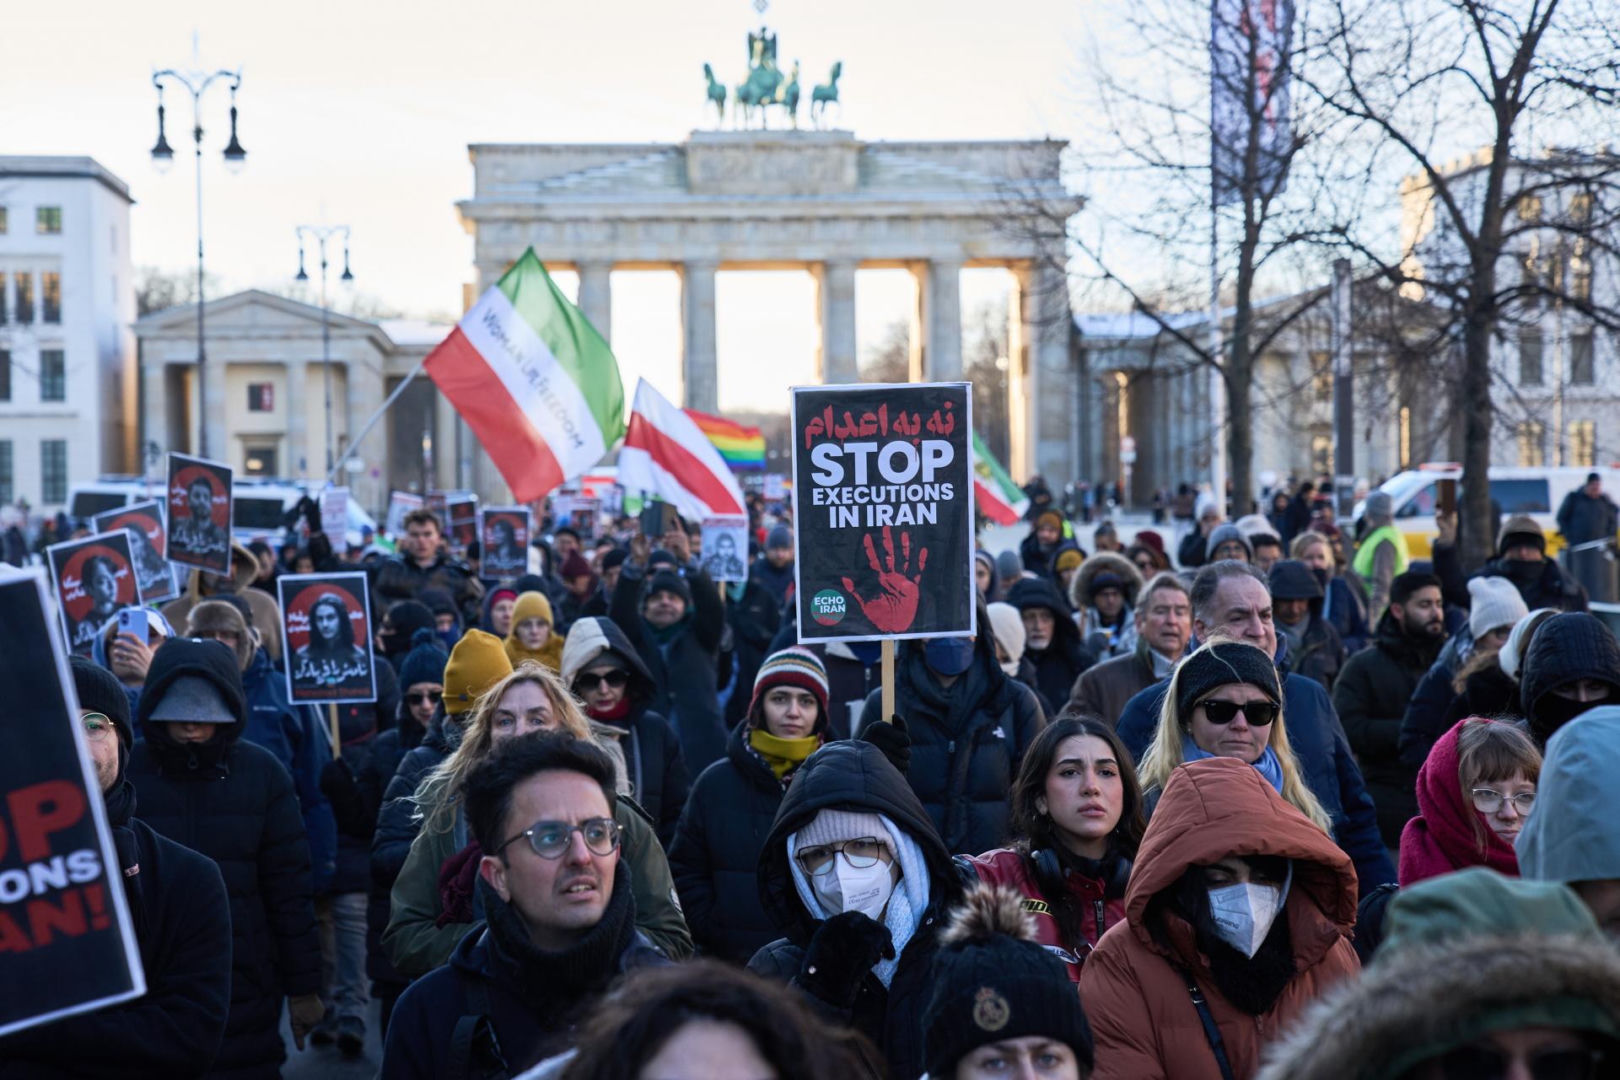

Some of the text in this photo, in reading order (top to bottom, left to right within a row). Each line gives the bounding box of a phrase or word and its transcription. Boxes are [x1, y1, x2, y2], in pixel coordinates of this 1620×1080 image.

[805, 401, 955, 449] نه به اعدام
[811, 440, 955, 487] STOP
[812, 483, 954, 506] EXECUTIONS
[829, 502, 937, 528] IN IRAN
[814, 596, 844, 606] ECHO
[820, 604, 846, 614] IRAN
[0, 780, 87, 864] P
